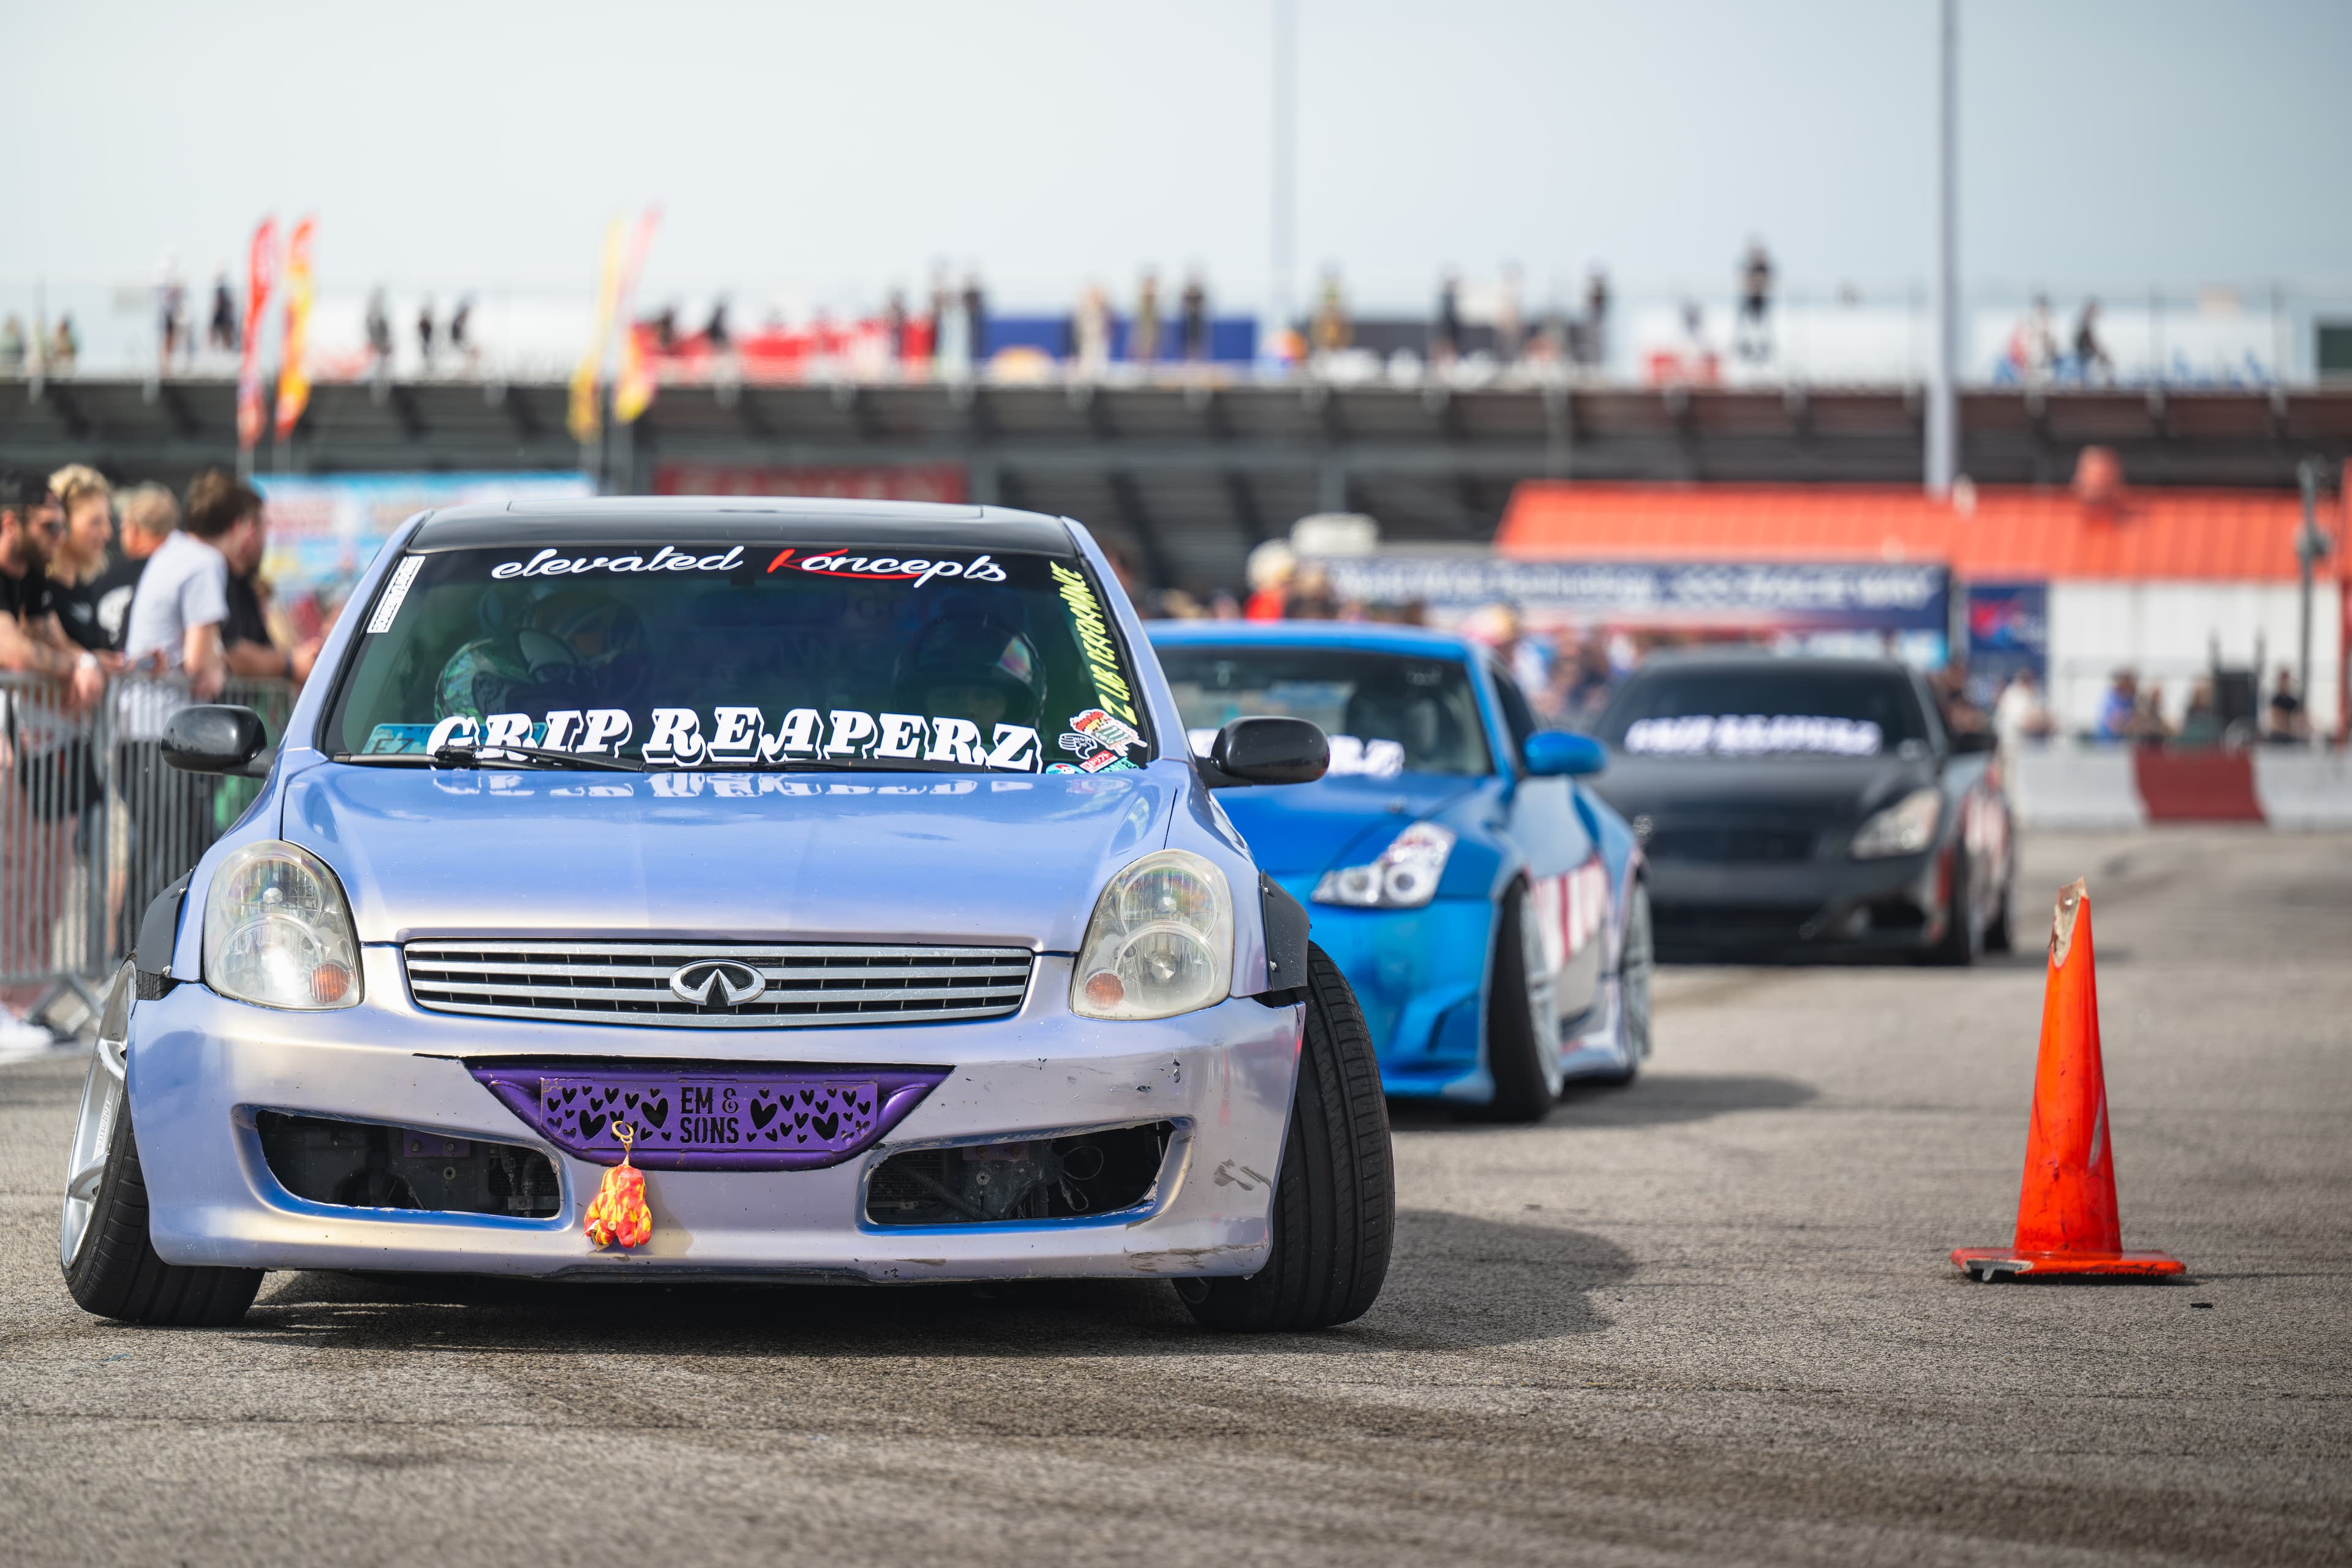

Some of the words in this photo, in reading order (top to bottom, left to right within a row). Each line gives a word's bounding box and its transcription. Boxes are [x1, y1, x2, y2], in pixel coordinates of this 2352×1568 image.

[491, 545, 744, 579] elevated
[1090, 663, 1131, 701] LAB
[1099, 693, 1138, 726] Z
[426, 708, 633, 770] GRIP
[641, 706, 1043, 775] REAPERZ
[680, 1087, 713, 1114] EM
[722, 1087, 739, 1114] &
[680, 1117, 739, 1144] SONS
